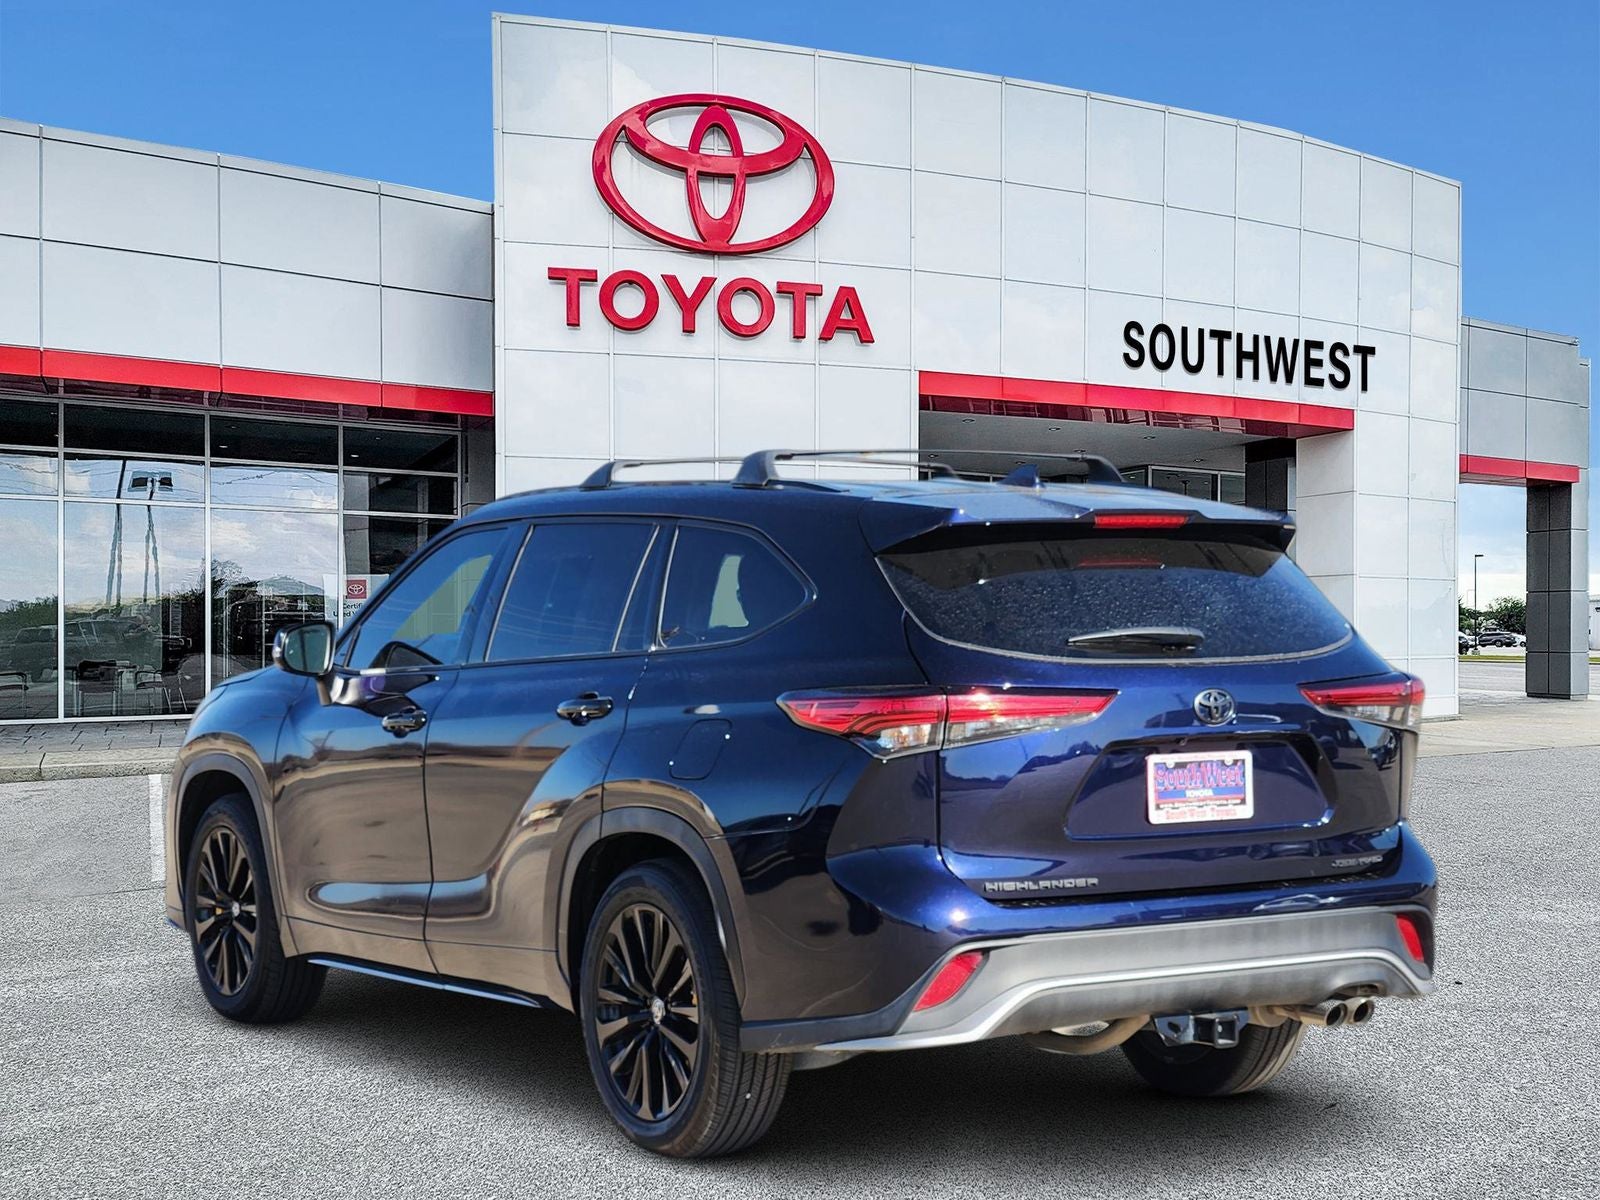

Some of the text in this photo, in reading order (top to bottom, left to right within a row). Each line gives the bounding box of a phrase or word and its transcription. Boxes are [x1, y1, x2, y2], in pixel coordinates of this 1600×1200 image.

[547, 266, 875, 344] TOYOTA
[1122, 320, 1376, 392] SOUTHWEST
[984, 877, 1099, 892] HIGHLANDER
